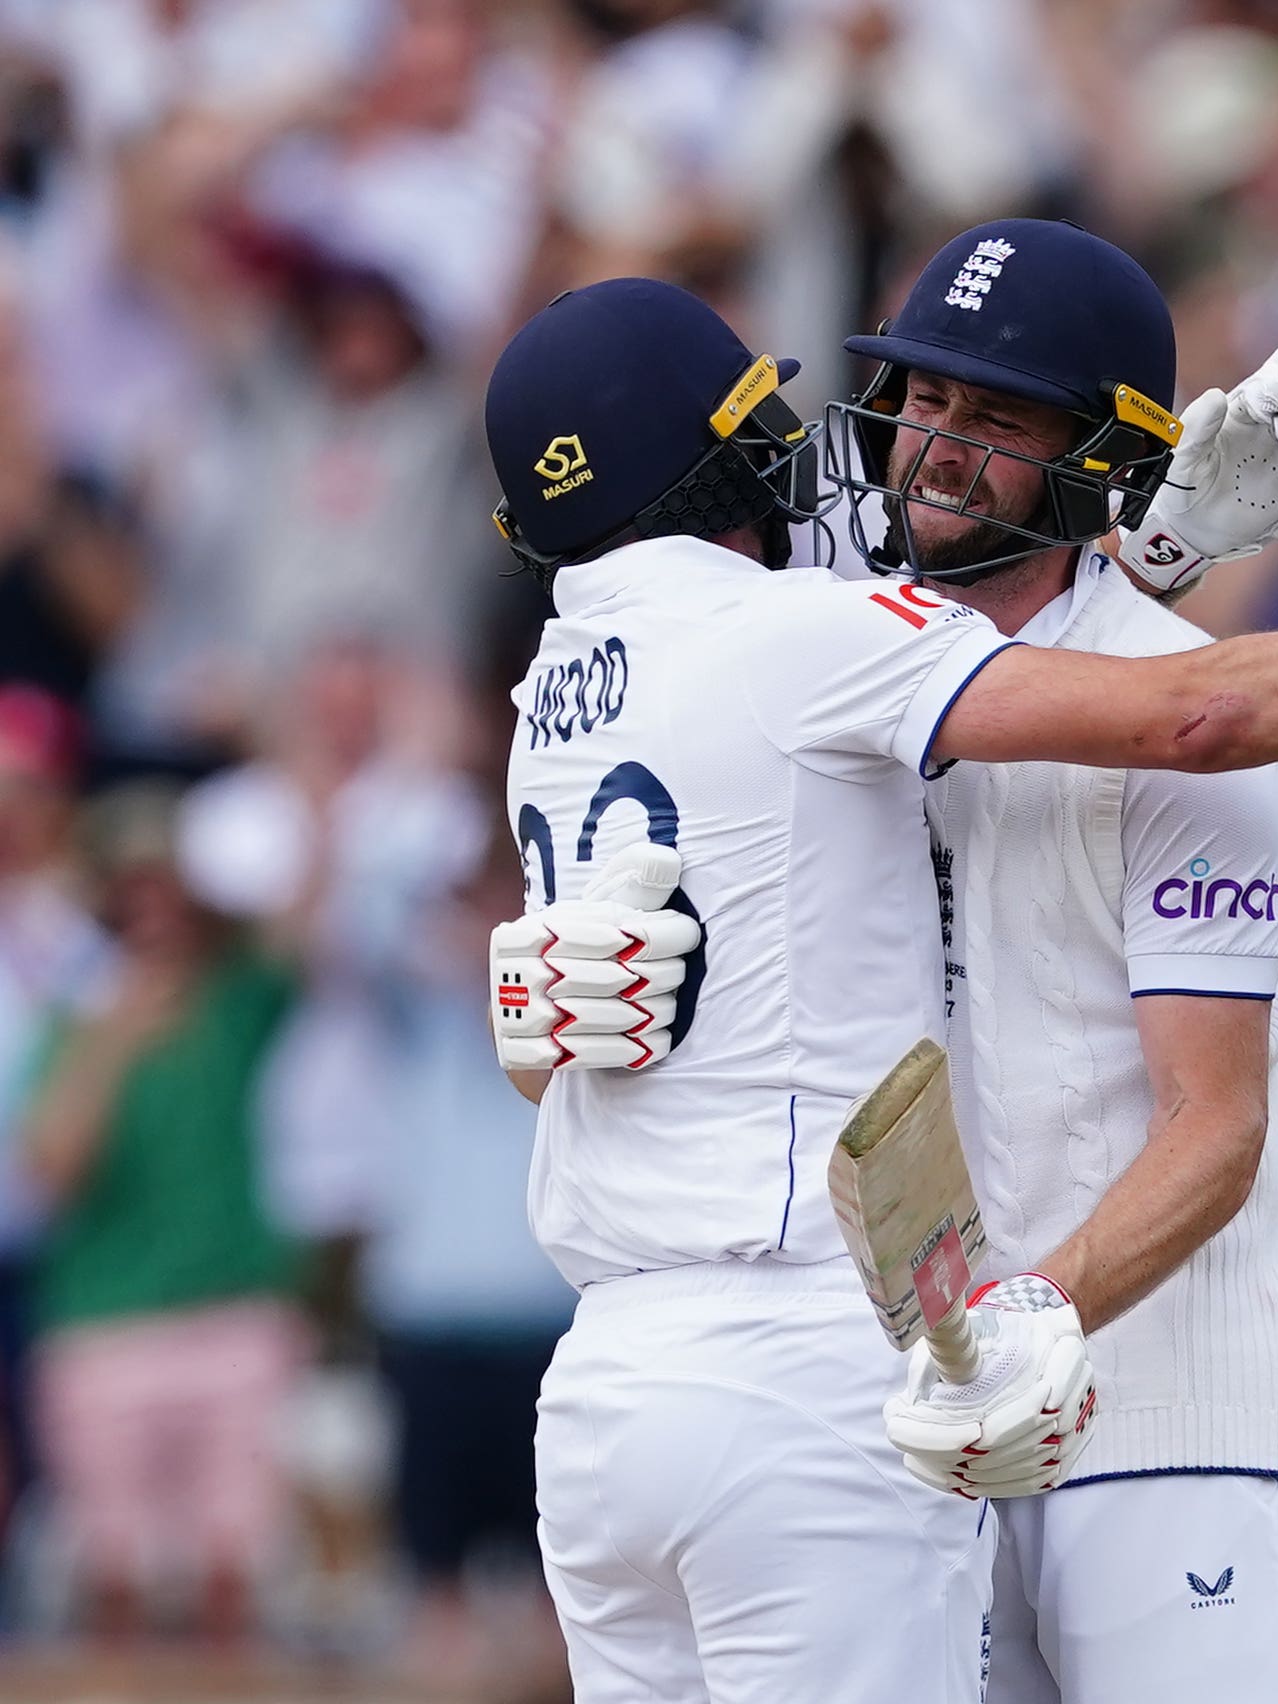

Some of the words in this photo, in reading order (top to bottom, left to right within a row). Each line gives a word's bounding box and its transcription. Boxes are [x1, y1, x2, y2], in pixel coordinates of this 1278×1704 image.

[735, 367, 768, 405] MASURI
[1129, 396, 1168, 427] MASURI
[542, 468, 594, 501] MASURI
[527, 636, 628, 751] WOOD
[1190, 1597, 1236, 1610] CASTORE
